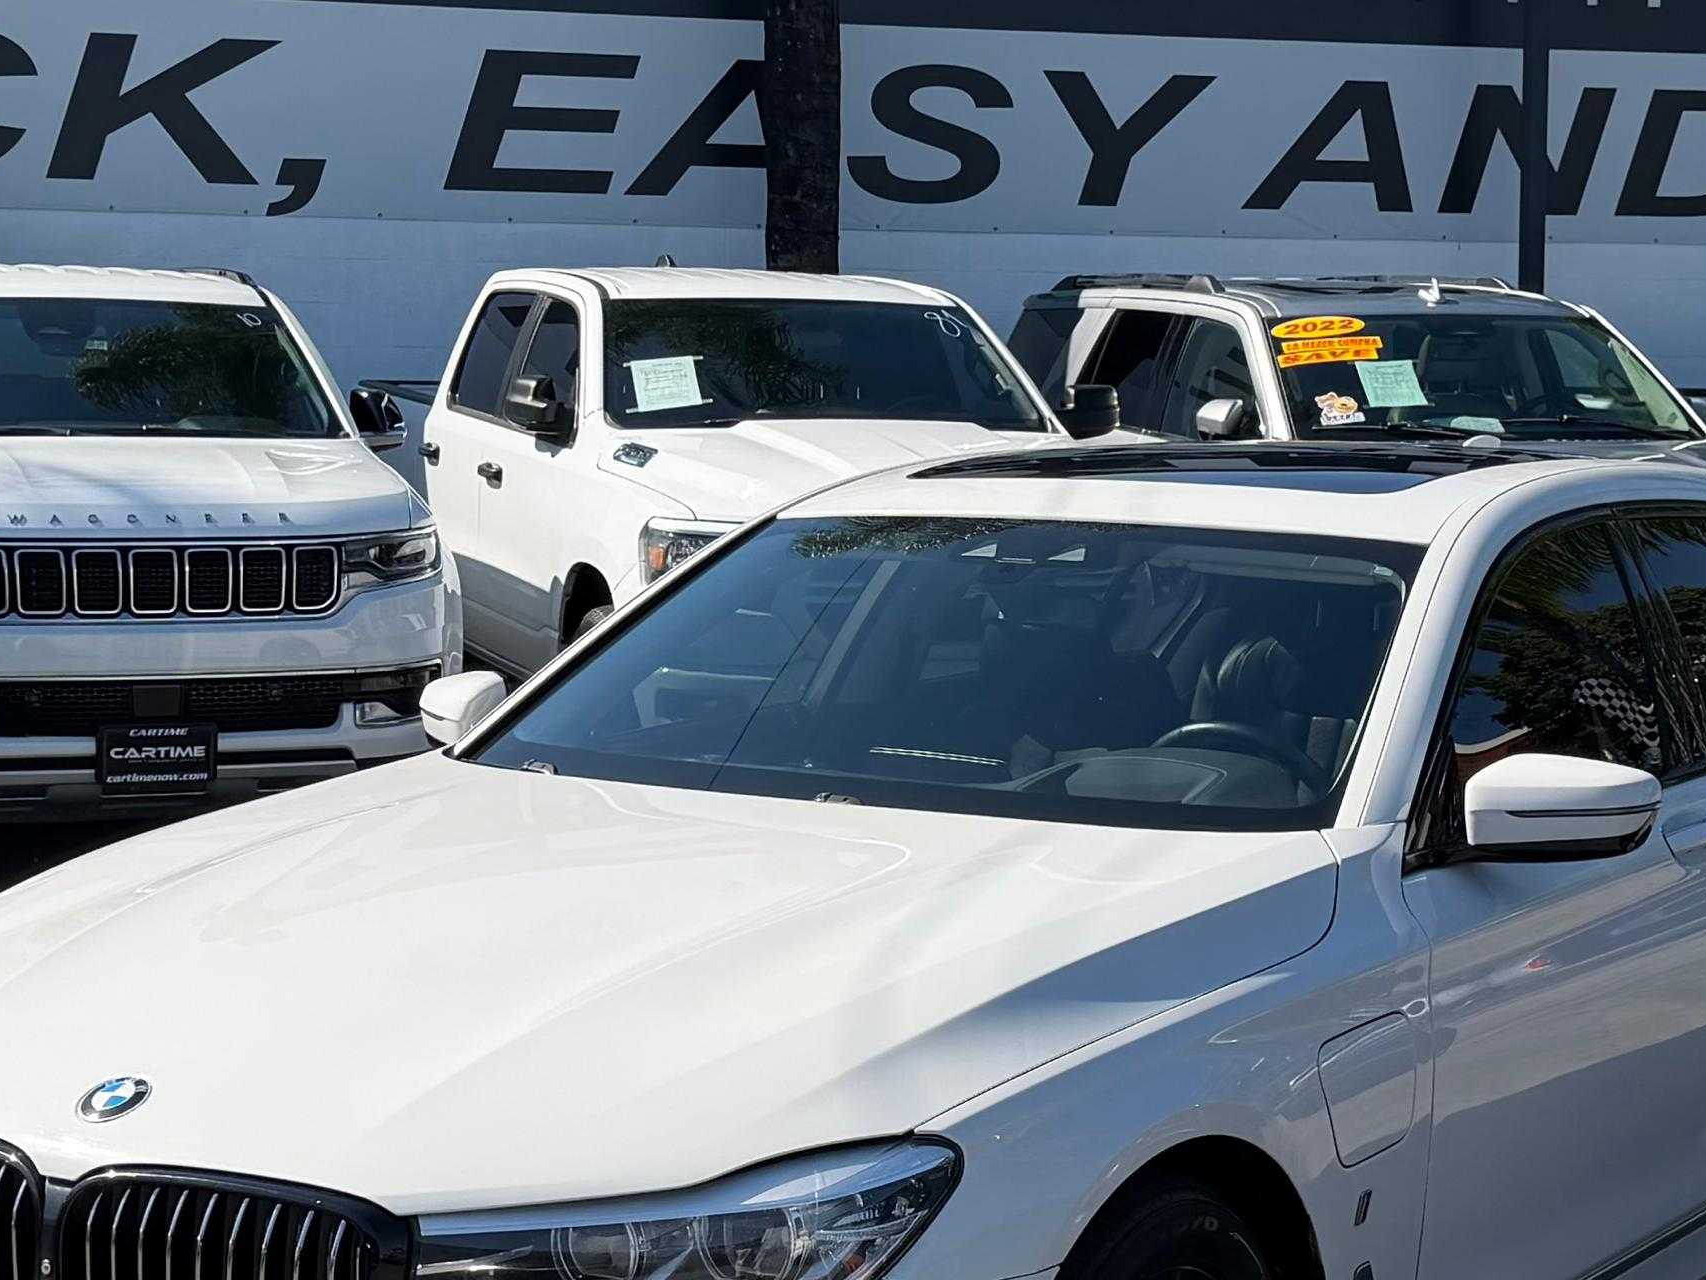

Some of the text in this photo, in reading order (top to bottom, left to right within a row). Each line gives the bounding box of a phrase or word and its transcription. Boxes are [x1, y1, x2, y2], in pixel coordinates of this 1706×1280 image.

[445, 49, 1216, 207] EASY
[1283, 319, 1355, 335] 2022
[1282, 349, 1371, 364] SAVE
[129, 726, 190, 737] CARTIME
[109, 744, 206, 759] CARTIME
